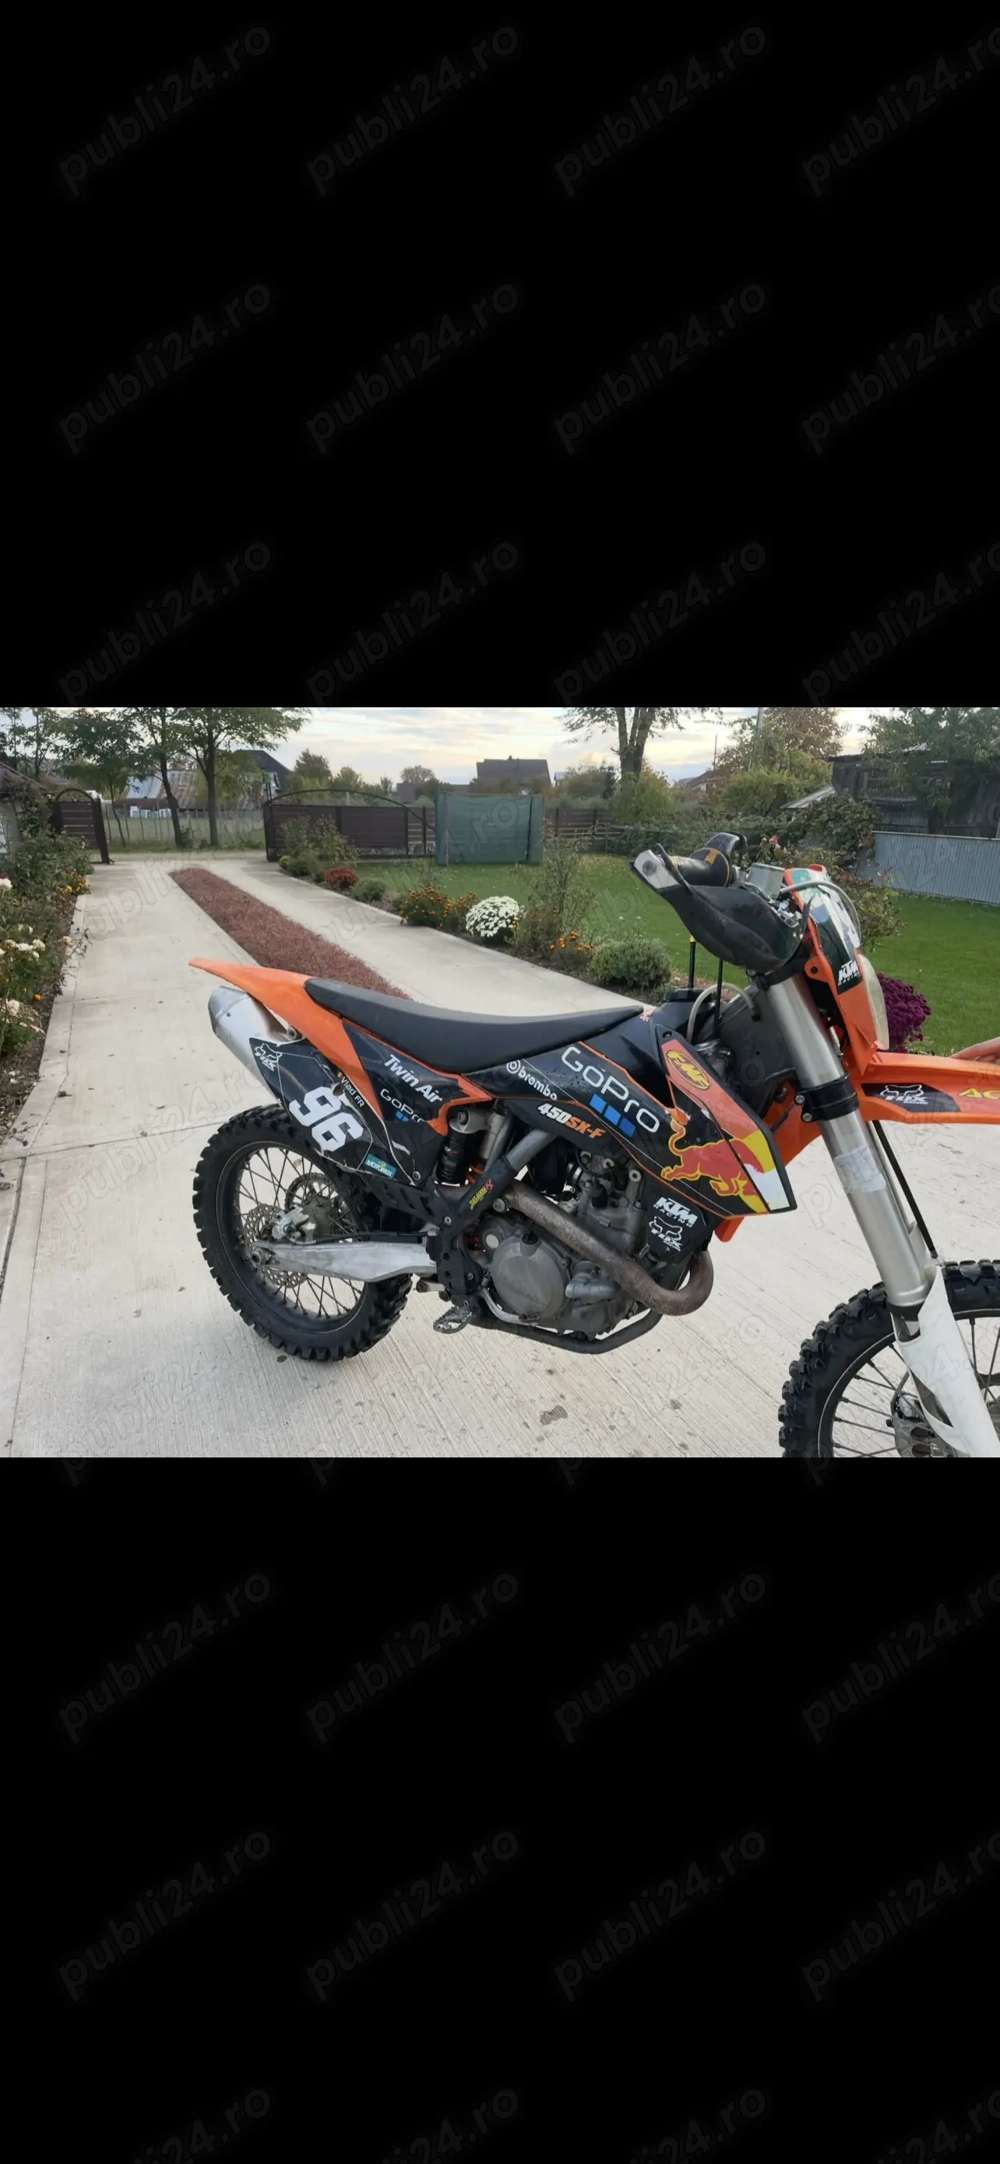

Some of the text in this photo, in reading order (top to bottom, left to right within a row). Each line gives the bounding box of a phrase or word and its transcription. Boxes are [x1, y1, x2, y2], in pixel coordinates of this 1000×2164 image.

[840, 960, 858, 981] KTM
[384, 1054, 443, 1103] Twin Air
[518, 1066, 557, 1100] brembo
[561, 1046, 660, 1133] GoPro
[289, 1087, 363, 1151] 96
[655, 1197, 698, 1224] KTM
